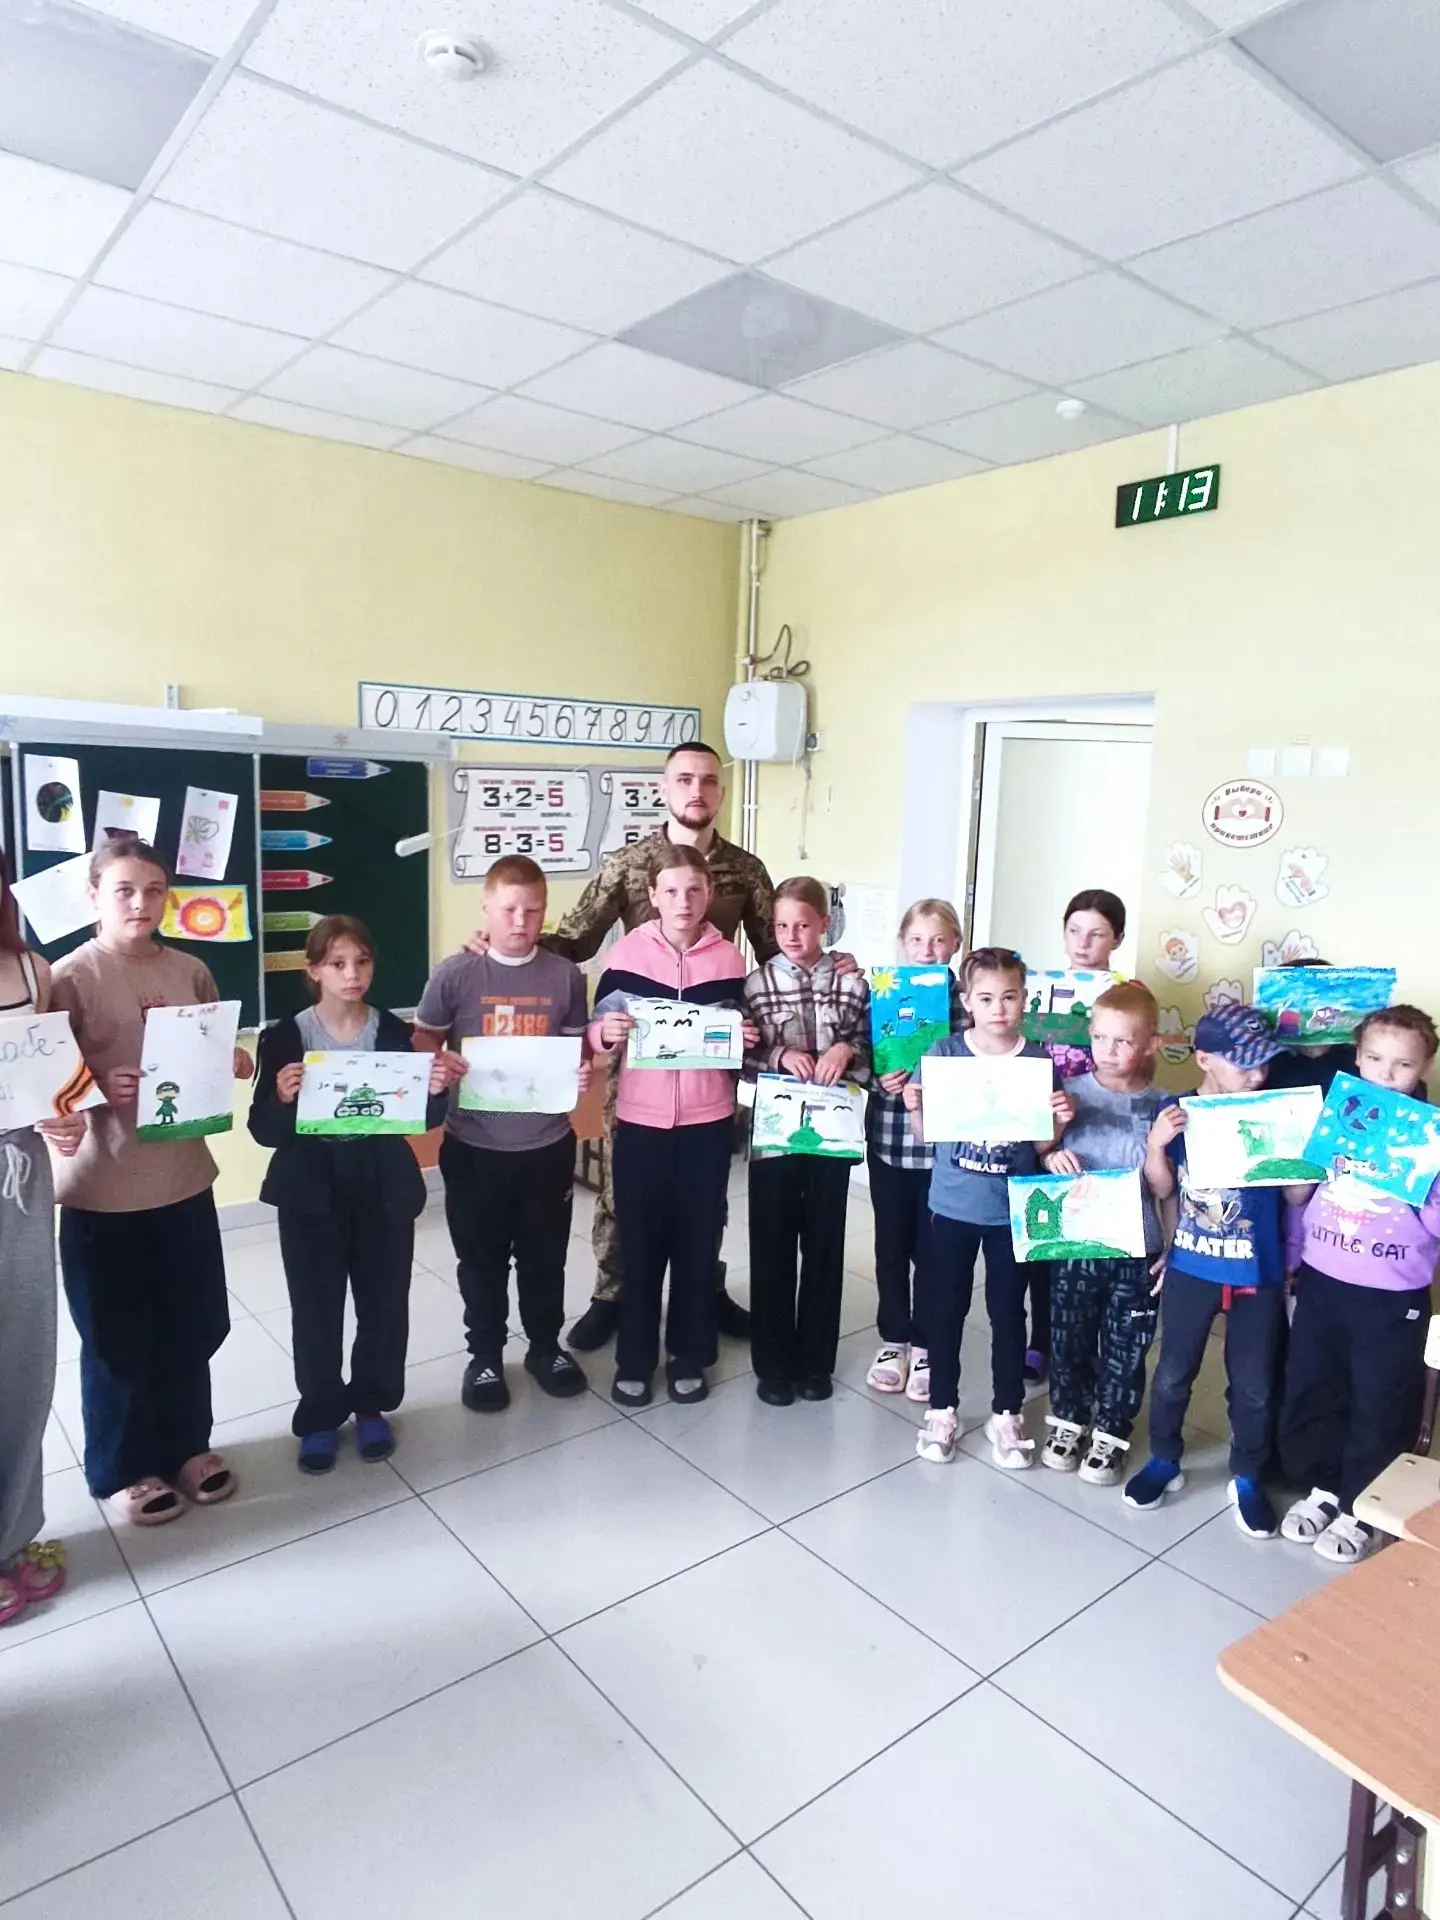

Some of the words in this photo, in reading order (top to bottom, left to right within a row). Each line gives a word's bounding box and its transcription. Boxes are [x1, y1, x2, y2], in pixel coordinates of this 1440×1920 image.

[375, 690, 398, 728] 0
[415, 694, 431, 730] 1
[439, 695, 463, 733] 2
[469, 698, 492, 734] 3
[503, 700, 520, 736] 4
[527, 704, 548, 737] 5
[554, 705, 574, 739] 6
[583, 708, 602, 741] 7
[609, 709, 627, 742] 8
[634, 711, 652, 743] 9
[662, 713, 697, 744] 10
[1174, 1228, 1254, 1259] SKATER
[1311, 1223, 1362, 1254] LITTLE
